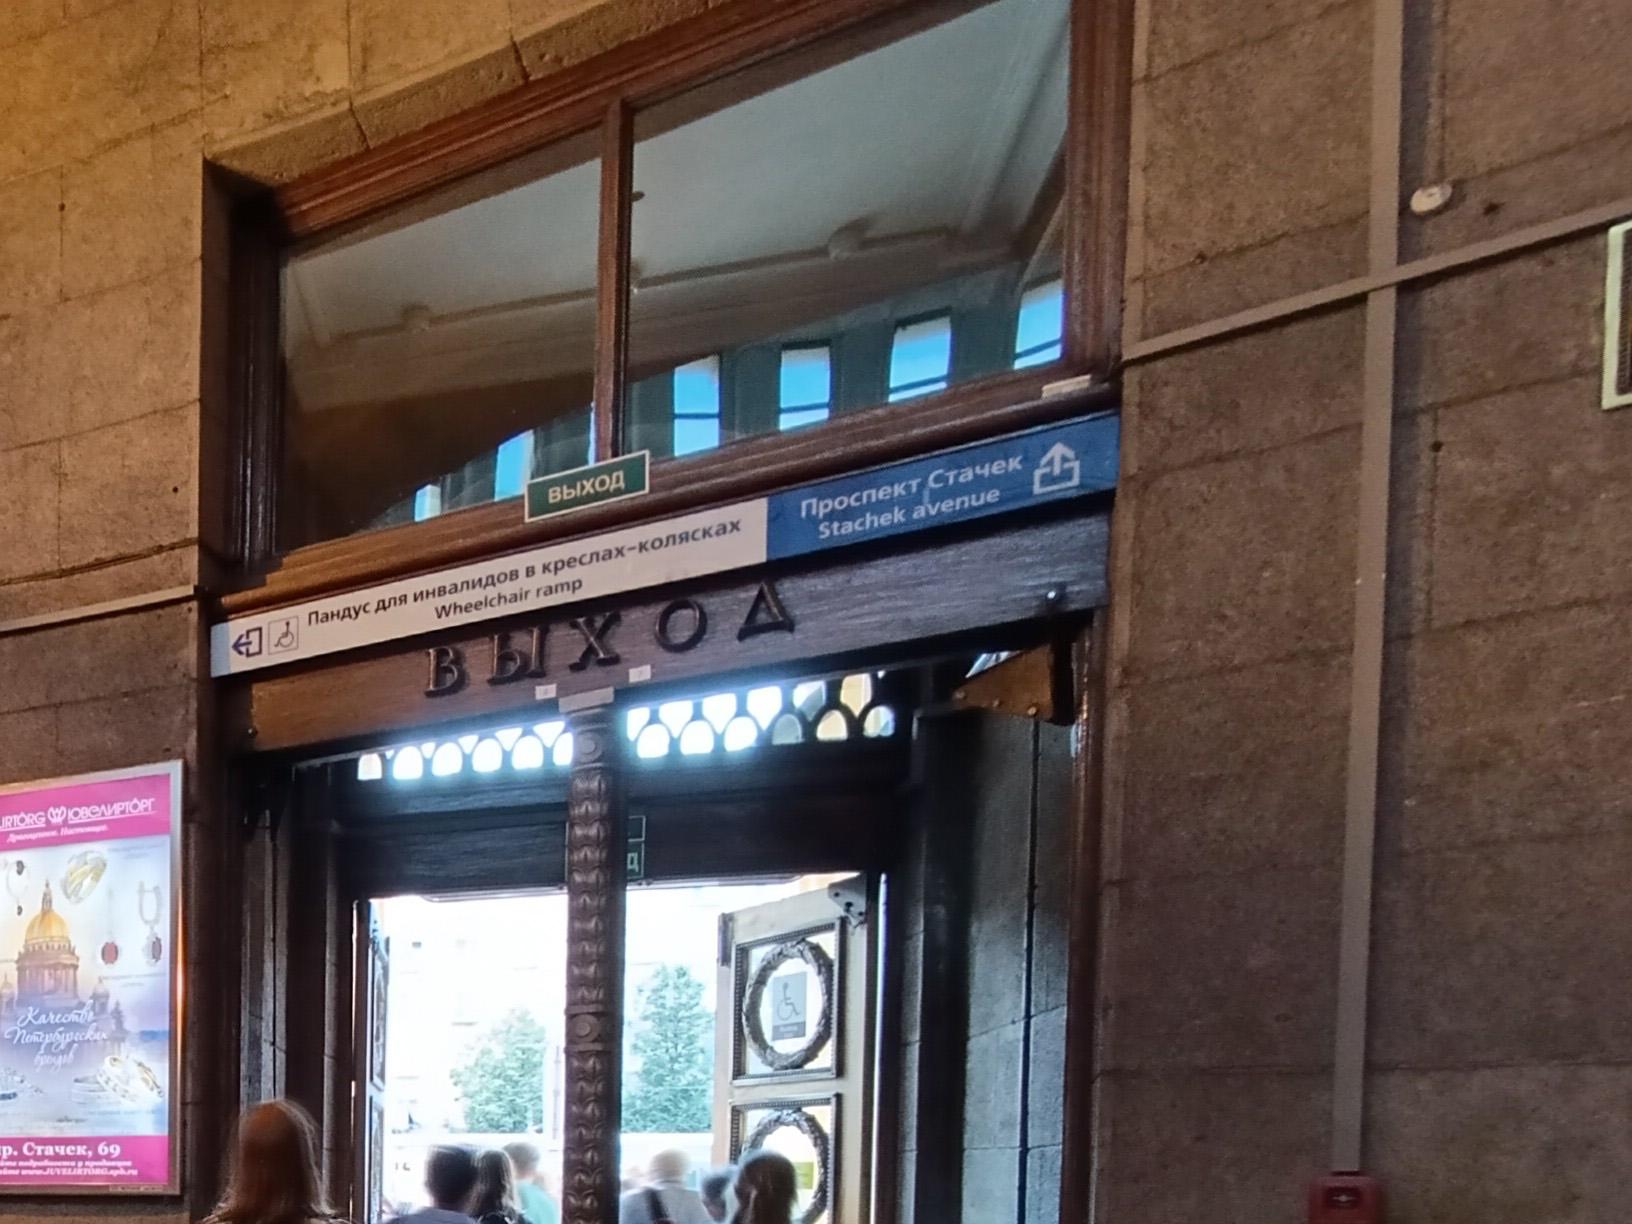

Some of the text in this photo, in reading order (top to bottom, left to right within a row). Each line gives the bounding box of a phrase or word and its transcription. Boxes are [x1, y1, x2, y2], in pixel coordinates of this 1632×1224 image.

[547, 469, 626, 505] ВЫХОД
[800, 452, 1024, 520] Проспект Стачек
[818, 487, 1001, 540] Stachek avenue
[307, 517, 742, 628] Пандус для инвалидов в креслах-колясках
[434, 576, 583, 620] Wheelchair ramp
[424, 581, 796, 698] ВЫХОД
[22, 1141, 93, 1159] Стачек,
[97, 1141, 121, 1157] 69
